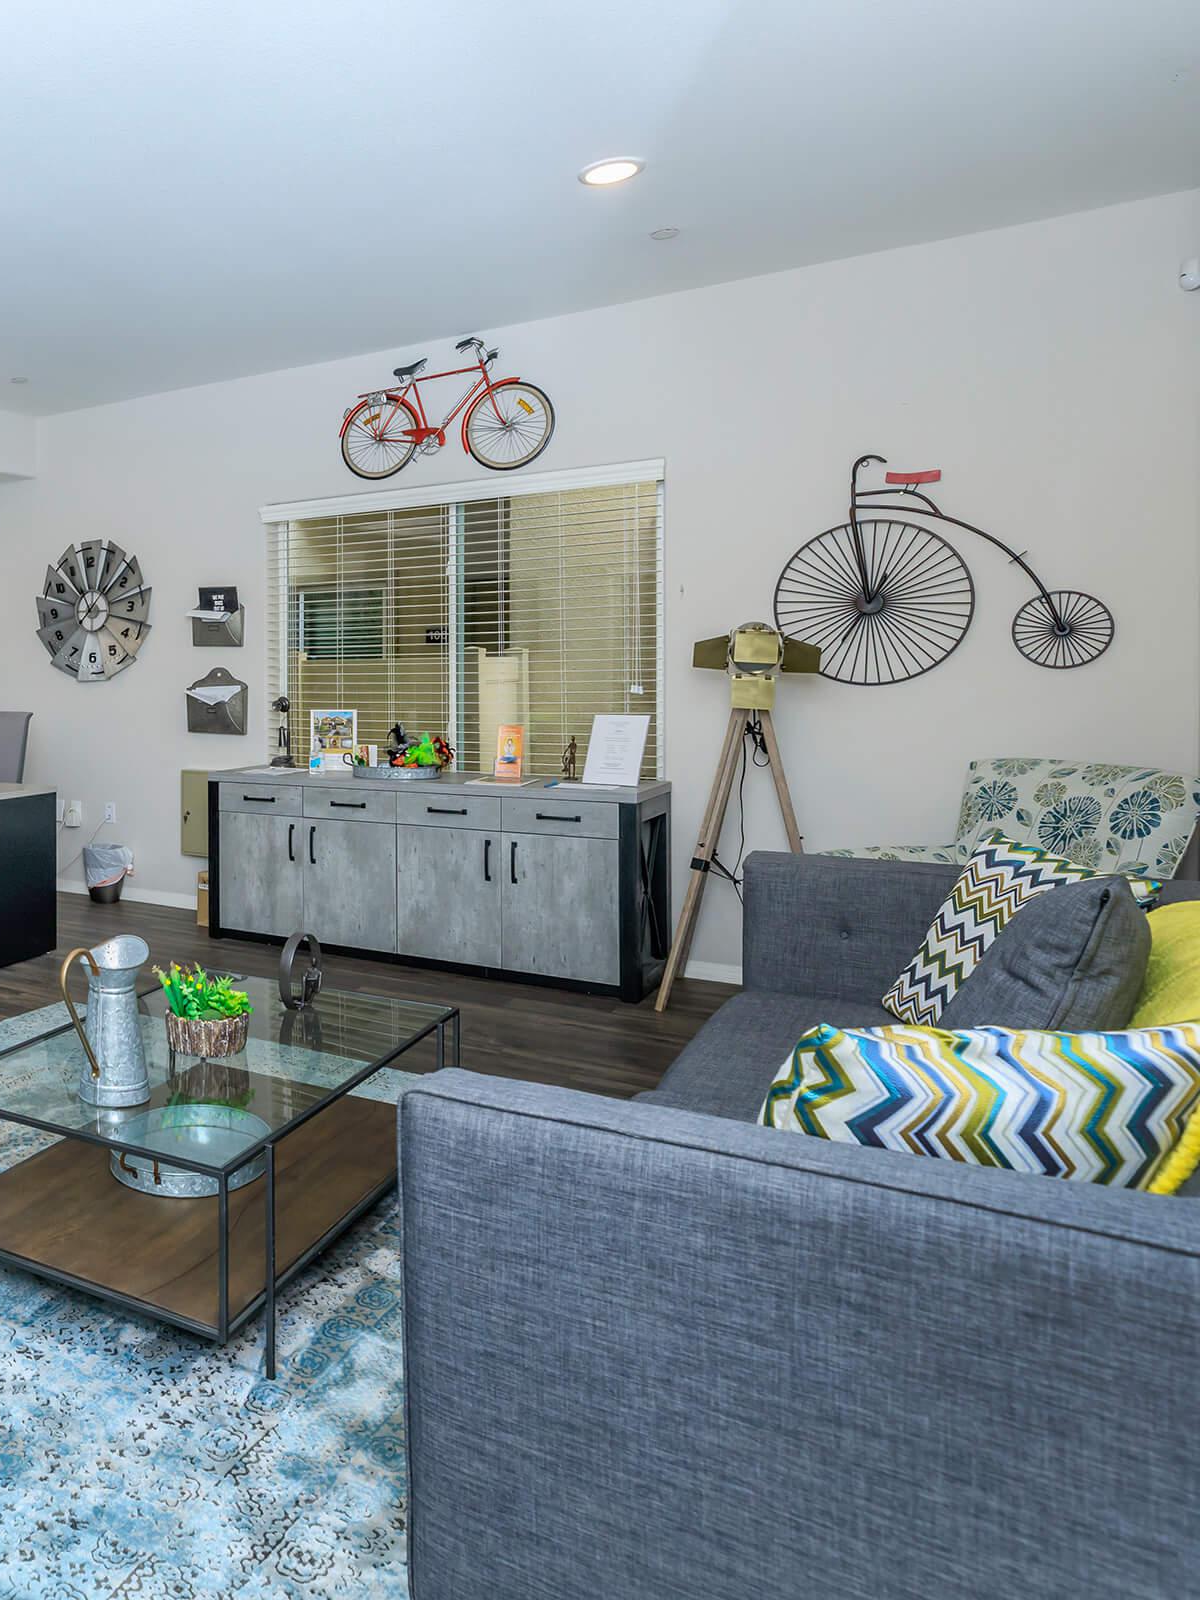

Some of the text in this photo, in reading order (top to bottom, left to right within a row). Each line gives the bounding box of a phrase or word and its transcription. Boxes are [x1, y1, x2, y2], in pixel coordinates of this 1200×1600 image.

[119, 577, 128, 588] 2
[55, 583, 65, 594] 10
[126, 601, 135, 612] 3
[50, 608, 58, 619] 9
[55, 630, 64, 641] 8
[120, 627, 130, 639] 4
[69, 646, 79, 657] 7
[108, 645, 117, 656] 5
[88, 652, 97, 663] 6
